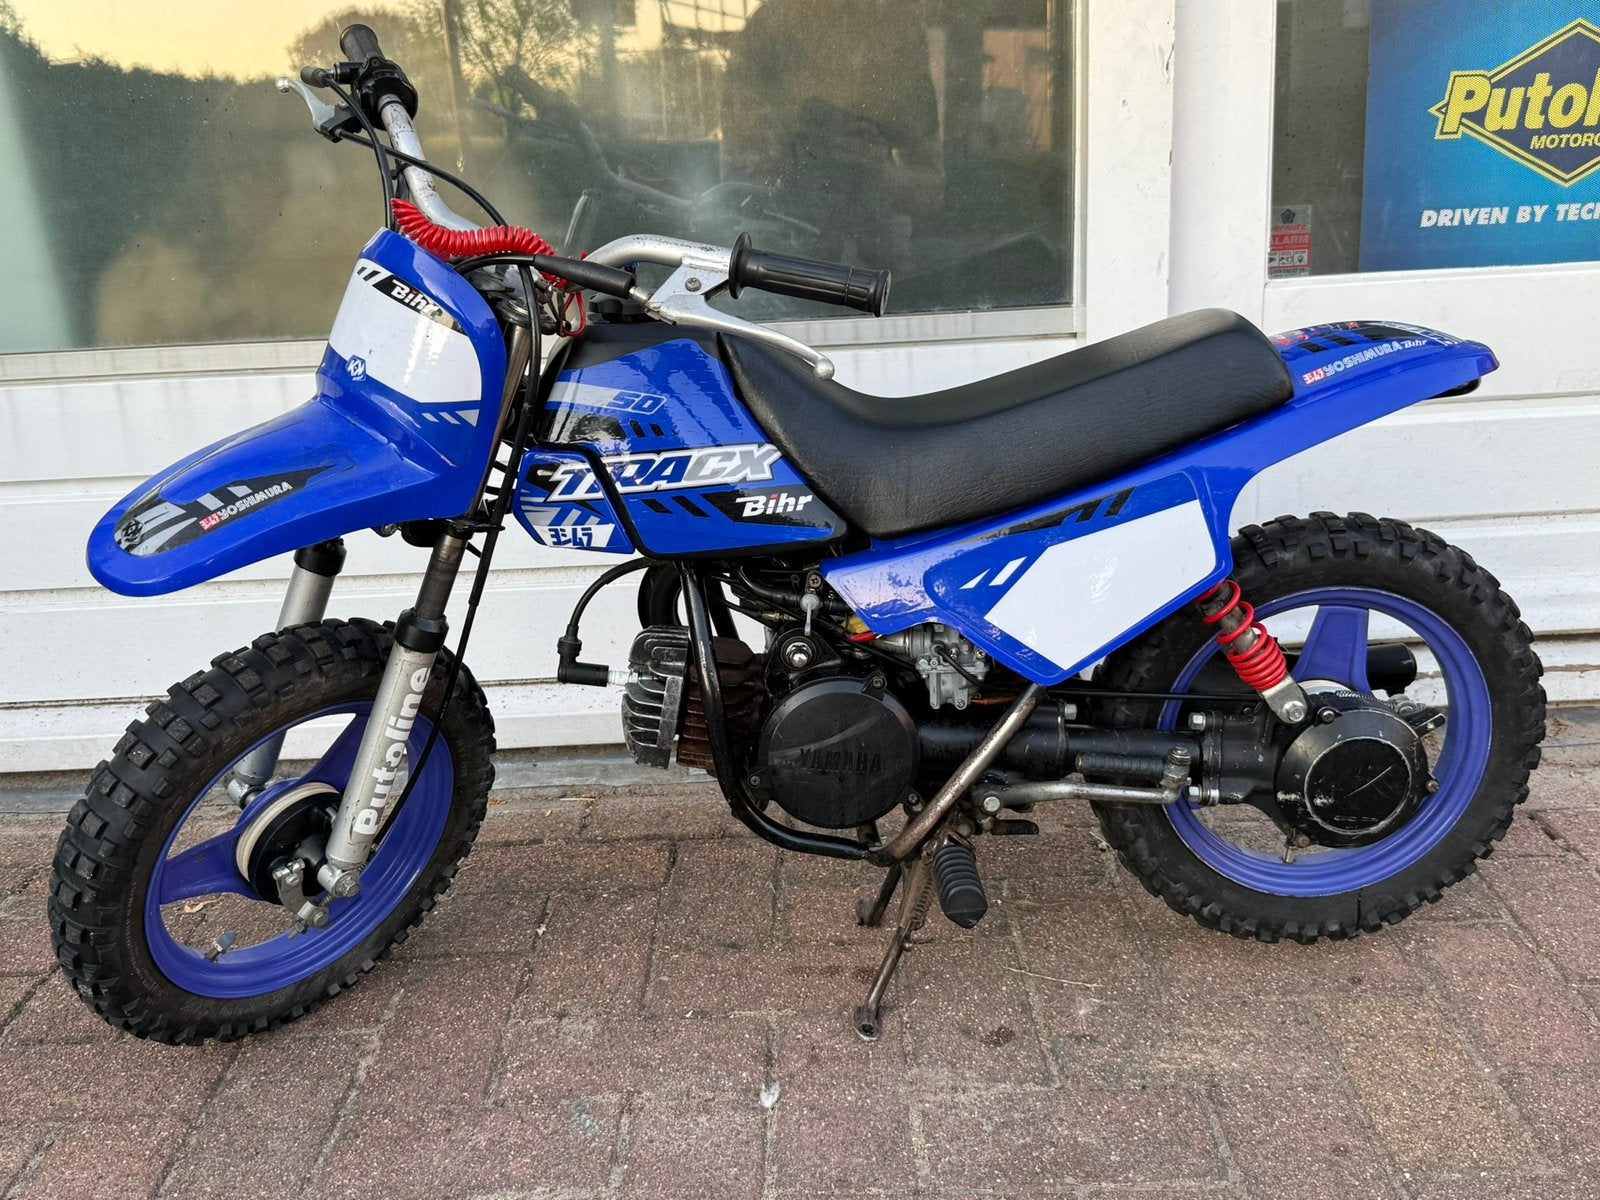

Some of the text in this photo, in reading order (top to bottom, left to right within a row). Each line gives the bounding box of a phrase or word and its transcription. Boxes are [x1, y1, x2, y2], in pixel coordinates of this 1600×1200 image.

[1420, 207, 1509, 227] DRIVEN
[1516, 205, 1549, 223] BY
[391, 279, 440, 314] Bihr
[1322, 339, 1427, 377] YOSHIMURA Bihr
[605, 390, 667, 414] 50
[216, 481, 293, 521] YOSHIMURA
[736, 493, 813, 517] Bihr
[799, 748, 882, 774] YAMAHA
